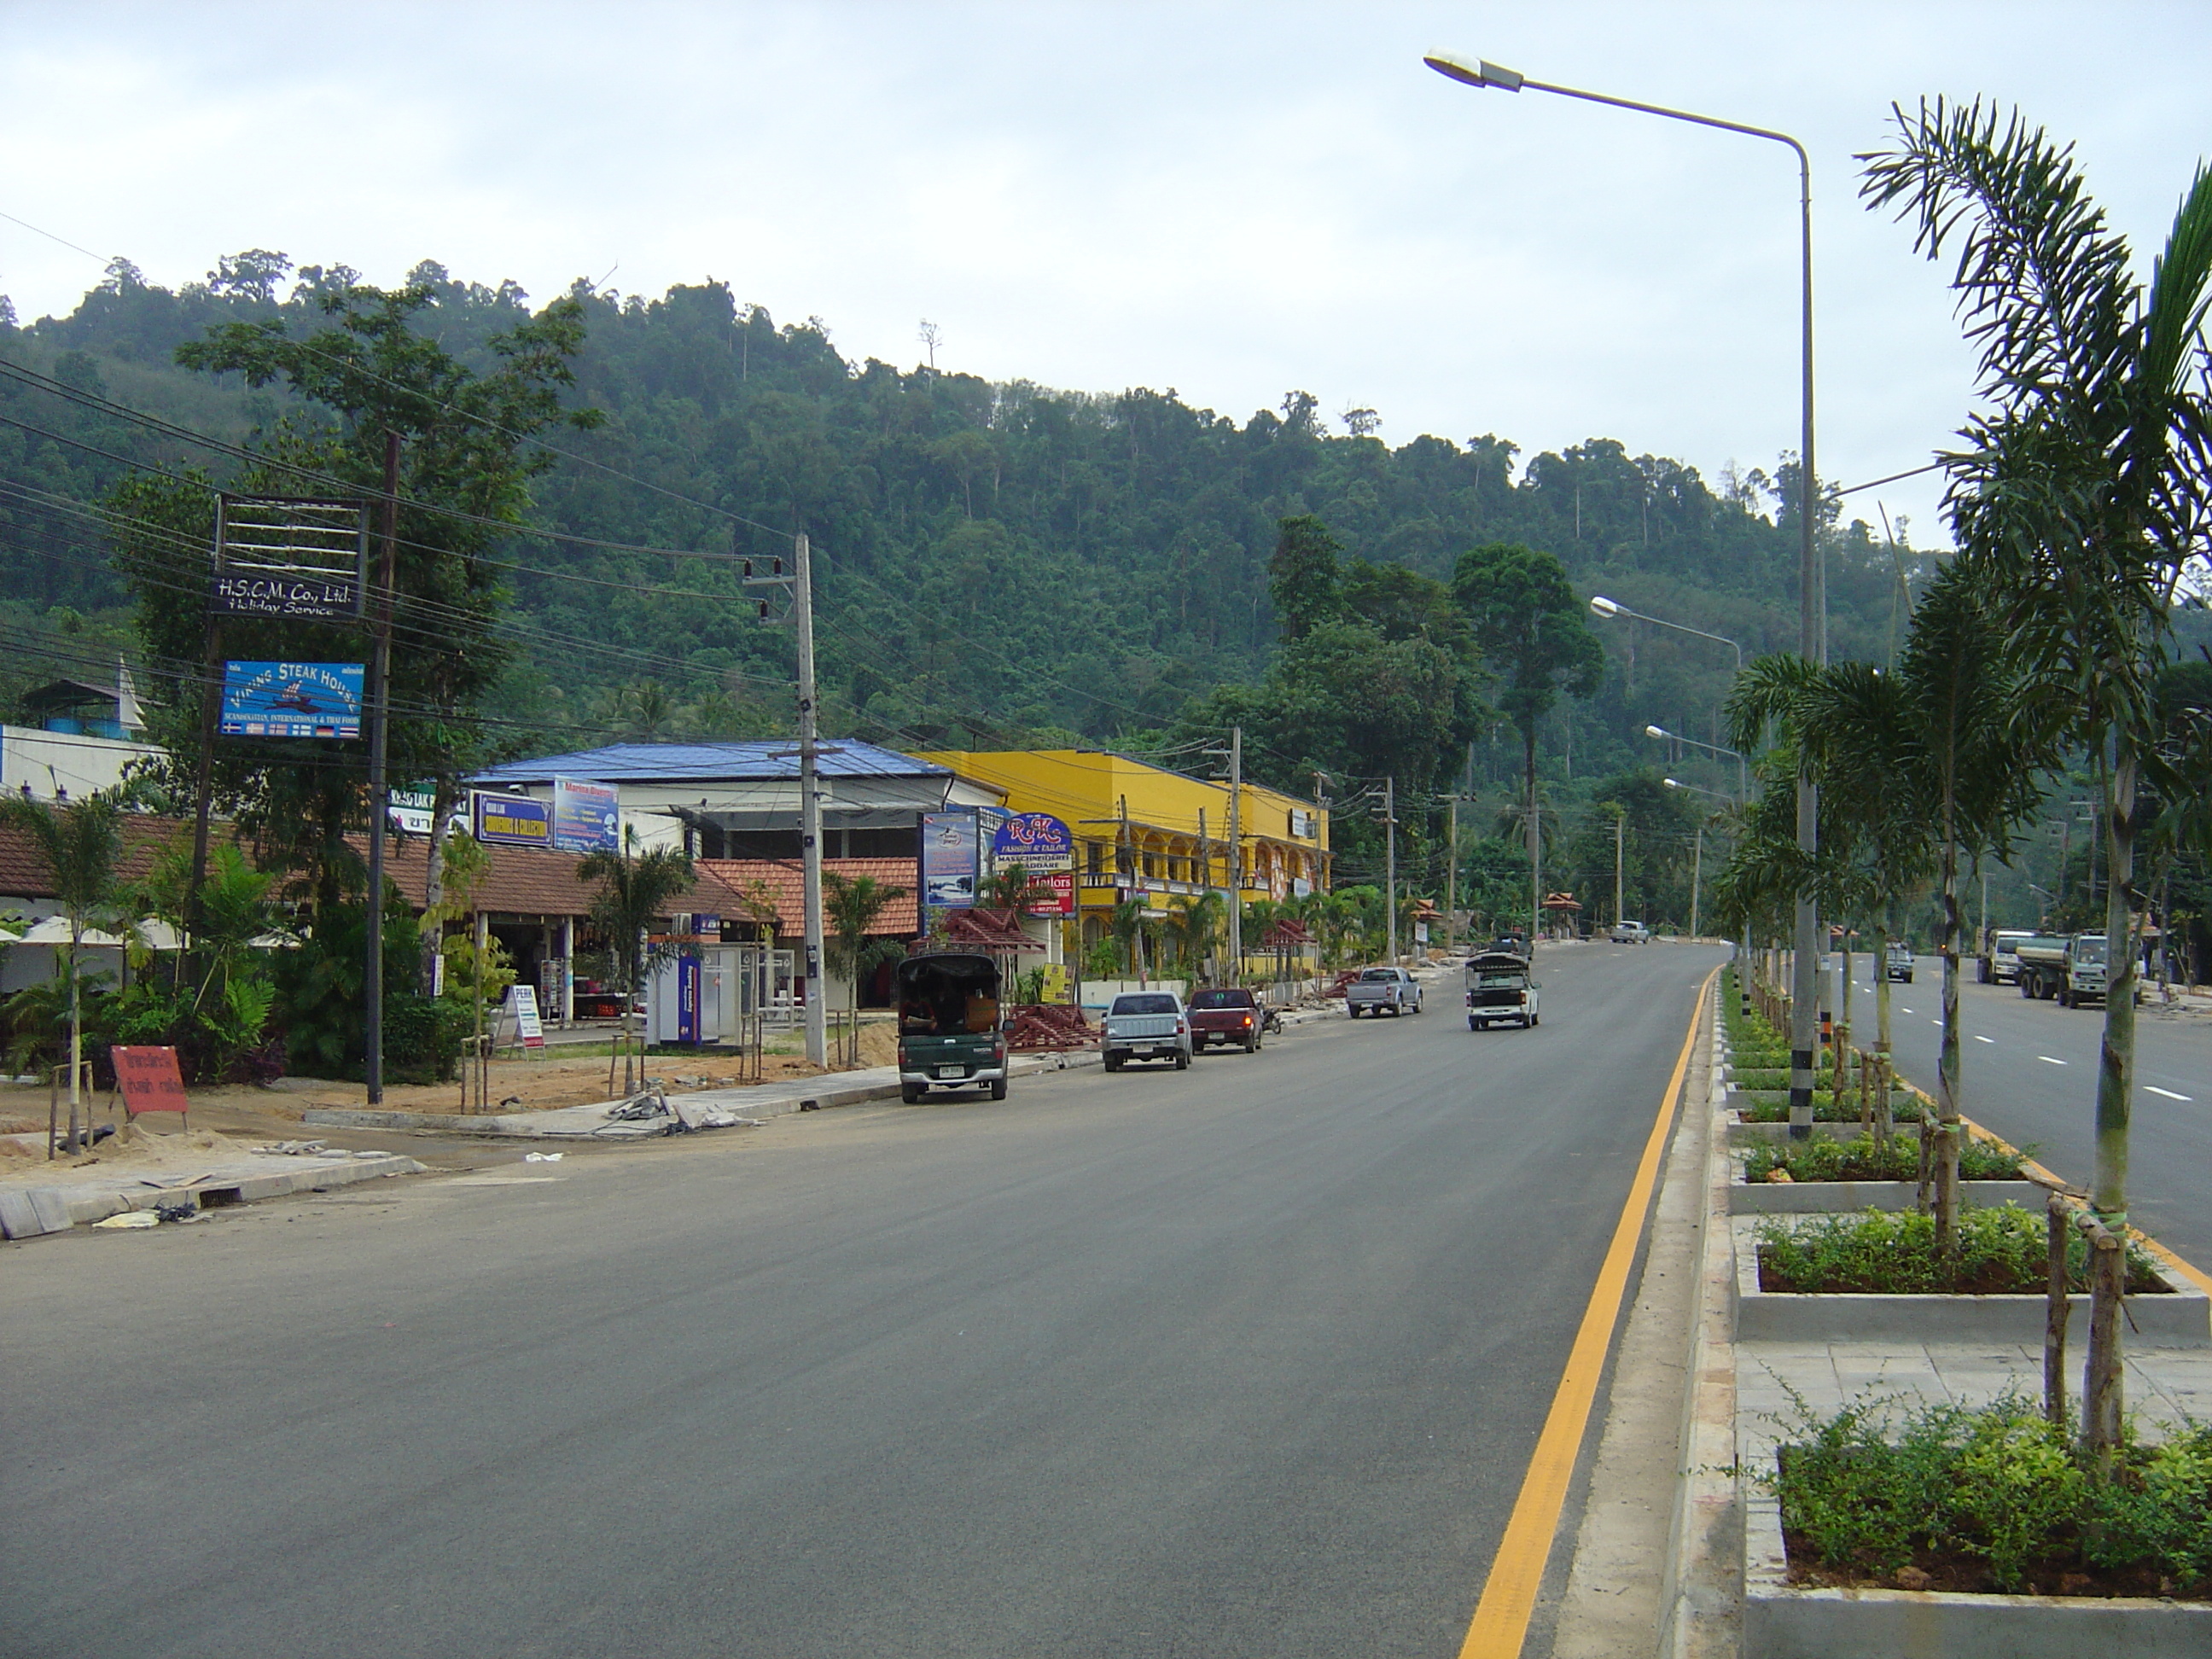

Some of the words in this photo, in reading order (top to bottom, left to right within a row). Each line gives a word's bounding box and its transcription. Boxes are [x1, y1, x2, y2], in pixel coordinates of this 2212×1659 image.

[218, 579, 286, 600] H.S.C.M.
[291, 583, 318, 604] Co.,
[323, 585, 352, 603] Ltd.
[229, 598, 281, 614] Holiday
[284, 602, 334, 616] Service
[279, 663, 317, 681] STEAK
[321, 670, 357, 713] HOUSE
[271, 714, 318, 724] INTERNATIONAL
[326, 716, 341, 725] THAI
[342, 716, 359, 725] FOOD
[414, 792, 429, 808] LAK
[1033, 875, 1071, 888] Tailors
